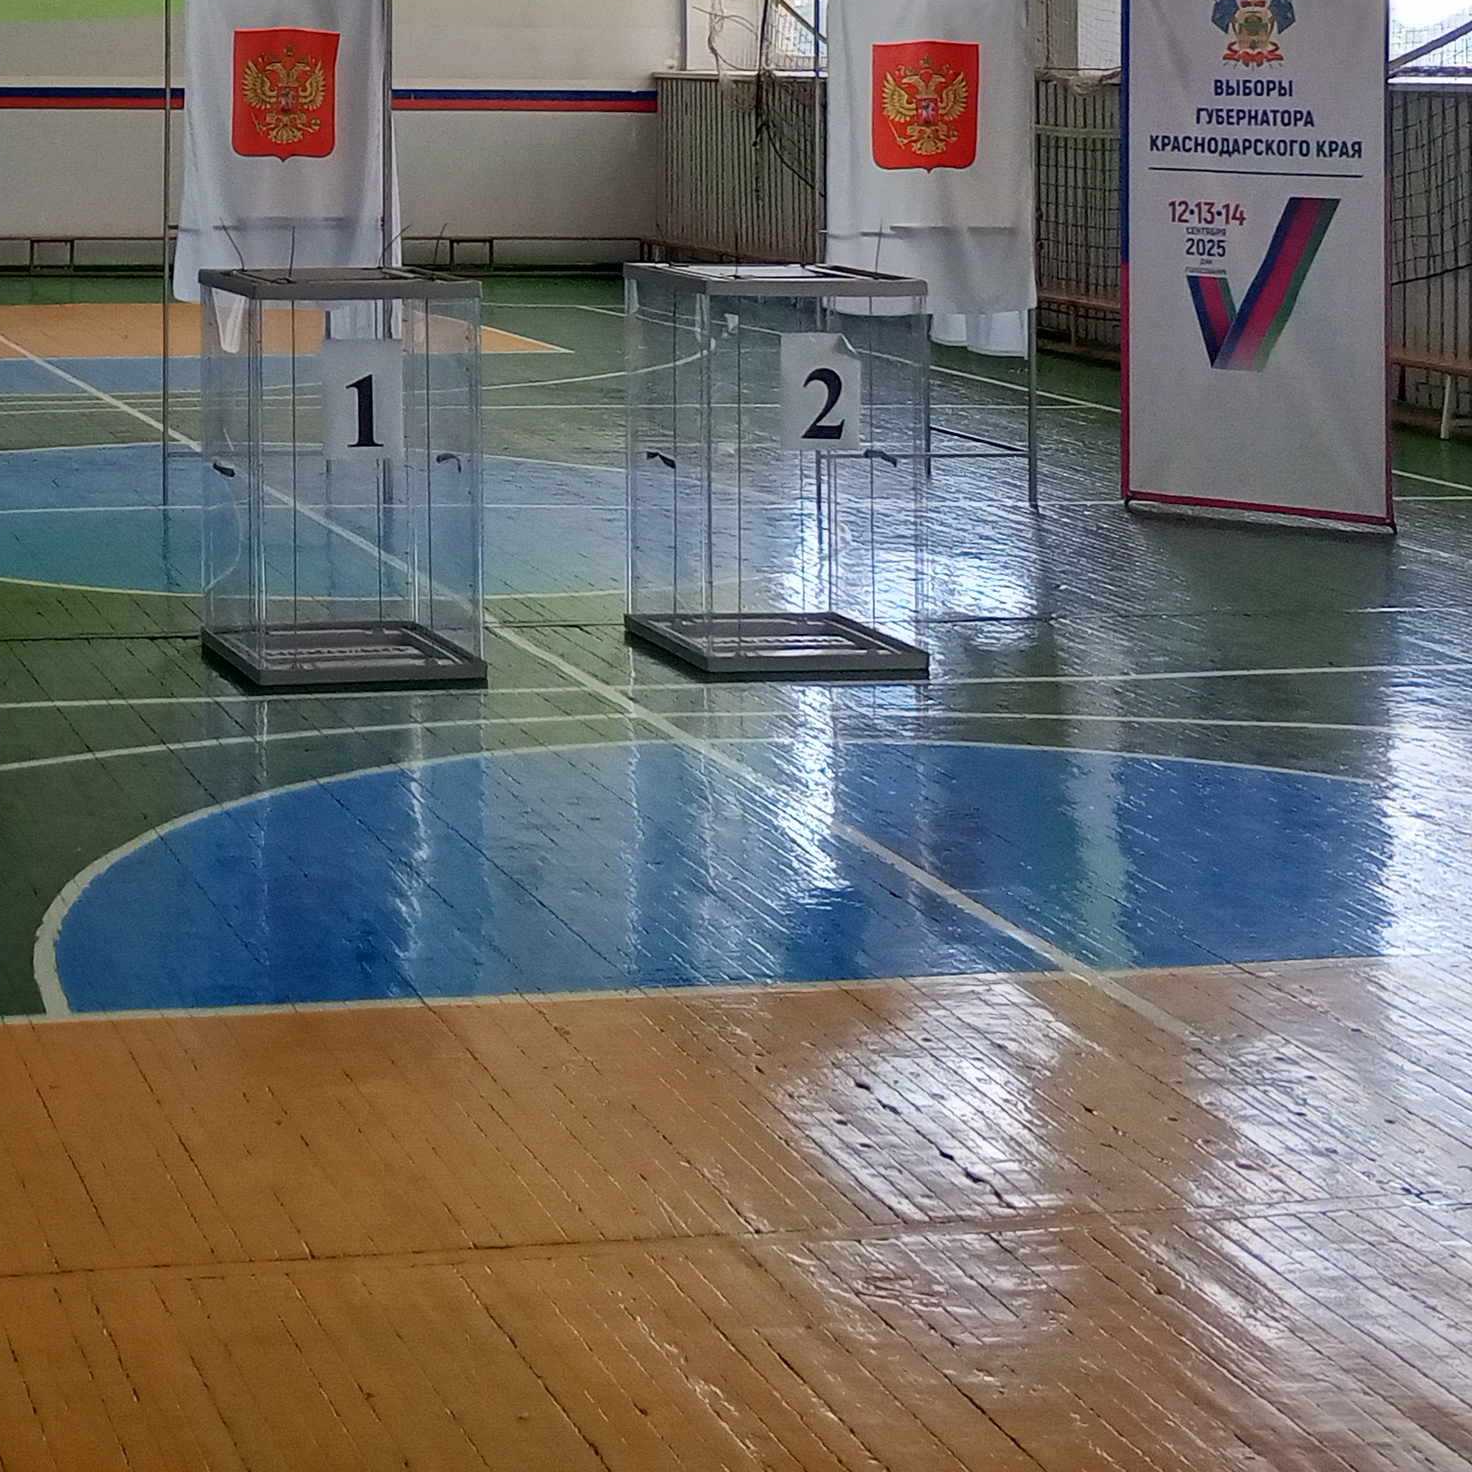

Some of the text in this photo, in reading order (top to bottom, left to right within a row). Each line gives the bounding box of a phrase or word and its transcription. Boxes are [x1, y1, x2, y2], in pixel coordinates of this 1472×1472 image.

[1214, 79, 1293, 97] ВЫБОРЫ
[1196, 107, 1315, 127] ГУБЕРНАТОРА
[1149, 134, 1363, 158] КРАСНОДАРСКОГО КРАЯ
[1185, 237, 1226, 257] 2025
[345, 374, 384, 447] 1
[801, 367, 845, 440] 2
